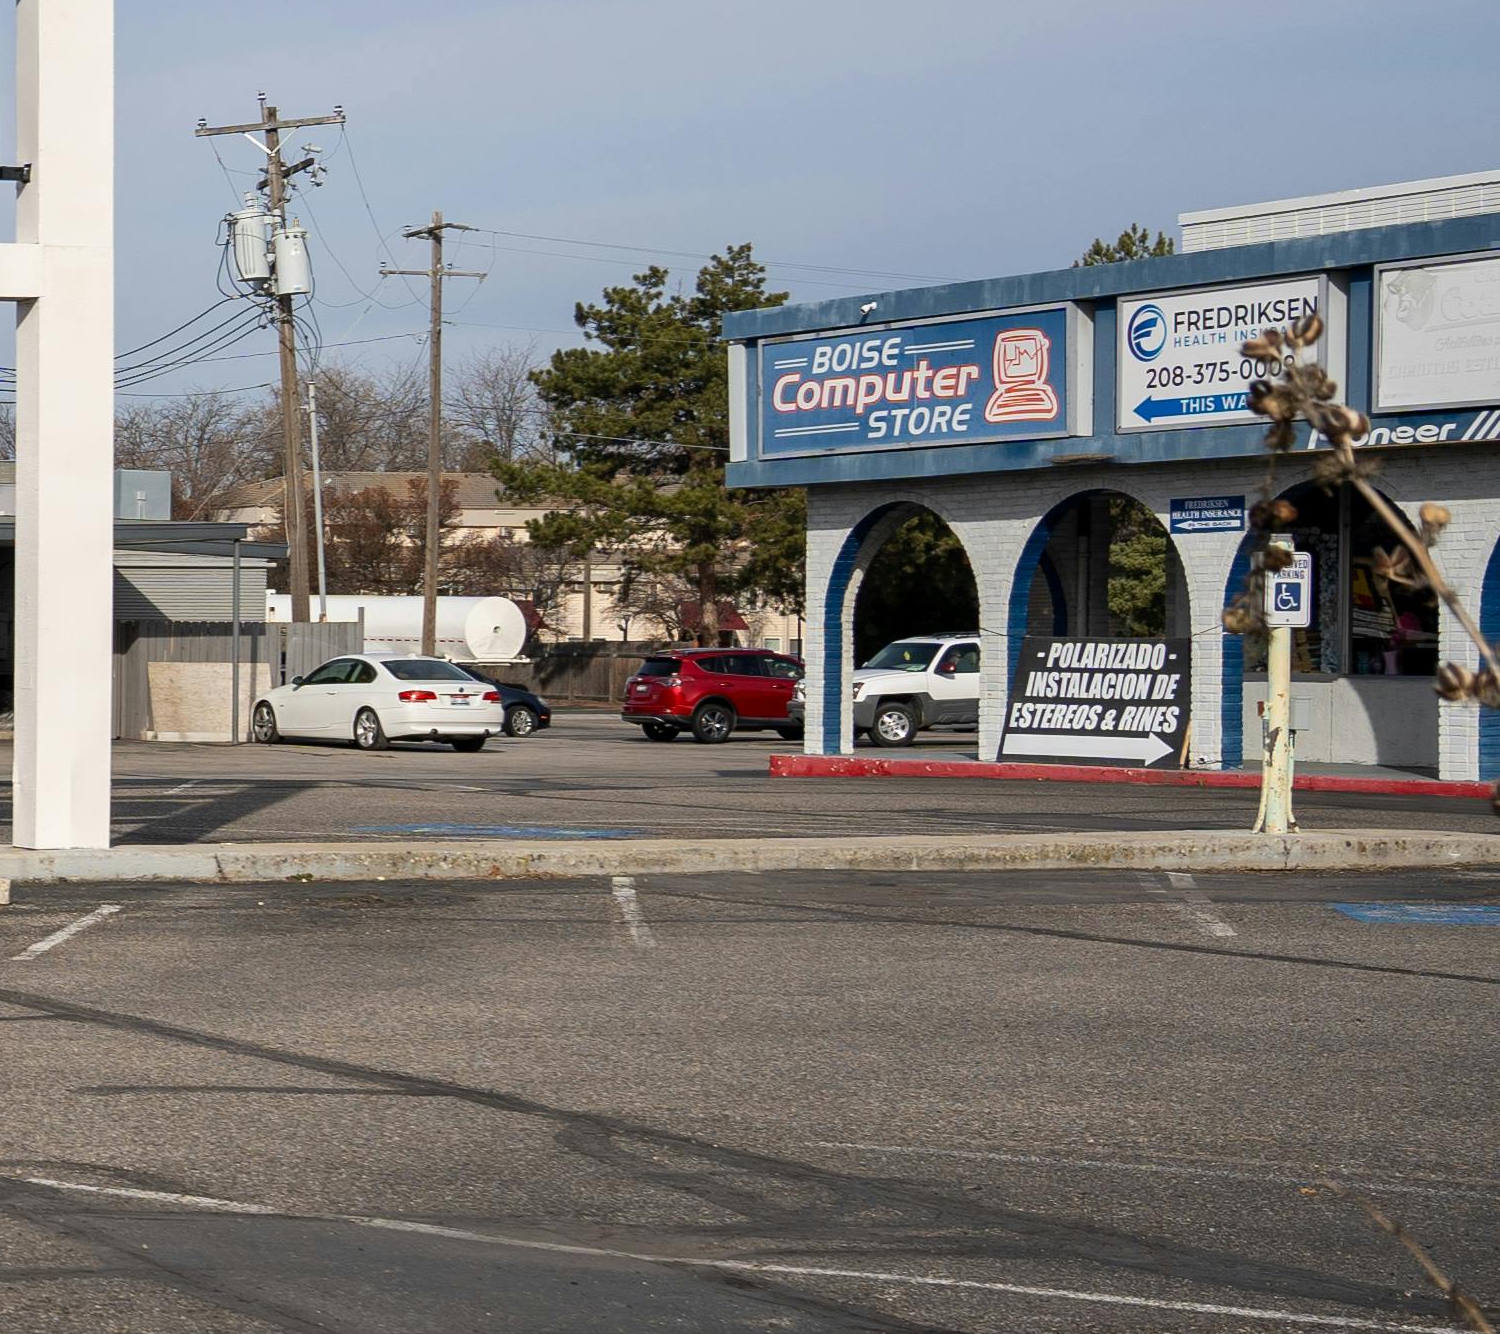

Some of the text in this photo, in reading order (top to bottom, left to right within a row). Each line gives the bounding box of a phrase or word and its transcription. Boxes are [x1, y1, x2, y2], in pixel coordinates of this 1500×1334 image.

[1173, 295, 1318, 334] FREDRIKSEN
[1173, 333, 1227, 348] HEALTH
[811, 337, 902, 375] BOISE
[772, 357, 980, 415] Computer
[1180, 395, 1249, 413] THIS WA
[866, 403, 973, 439] STORE
[1172, 508, 1242, 519] HEALTH INSURANCE
[1046, 642, 1167, 671] POLARIZADO
[1025, 671, 1181, 700] INSTALACION DE
[1009, 702, 1180, 734] ESTEREOS & RINES
